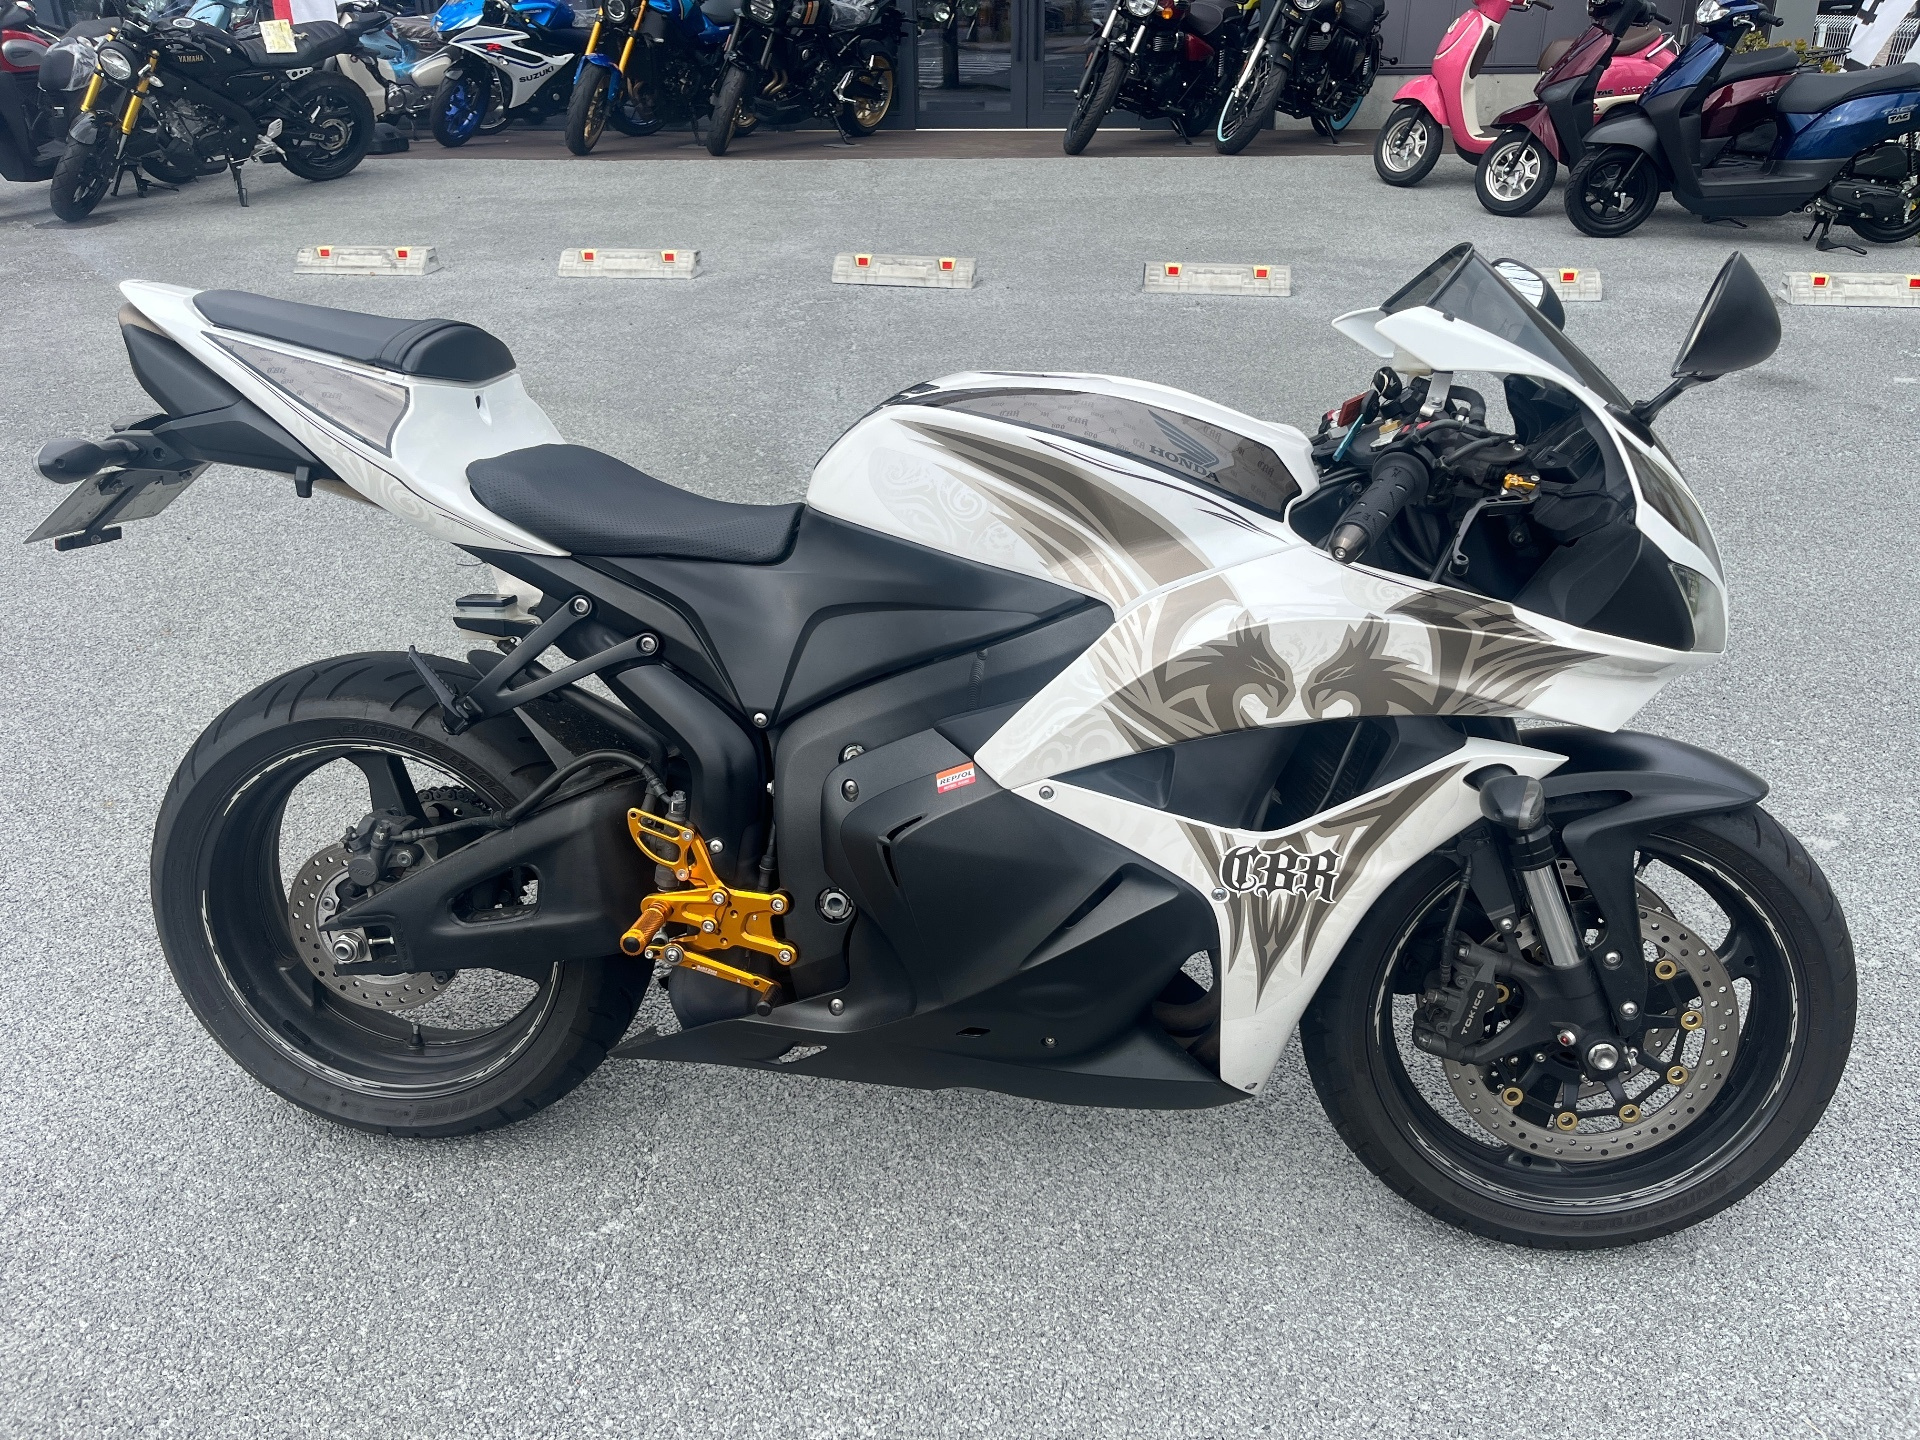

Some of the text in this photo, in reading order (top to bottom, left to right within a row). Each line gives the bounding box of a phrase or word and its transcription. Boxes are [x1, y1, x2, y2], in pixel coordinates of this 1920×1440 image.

[177, 54, 205, 63] YAMAHA
[518, 65, 555, 83] SUZUKI
[1149, 444, 1221, 484] HONDA
[939, 770, 972, 786] REPSOL
[1219, 844, 1342, 905] CBR
[1460, 988, 1486, 1036] TOKICO
